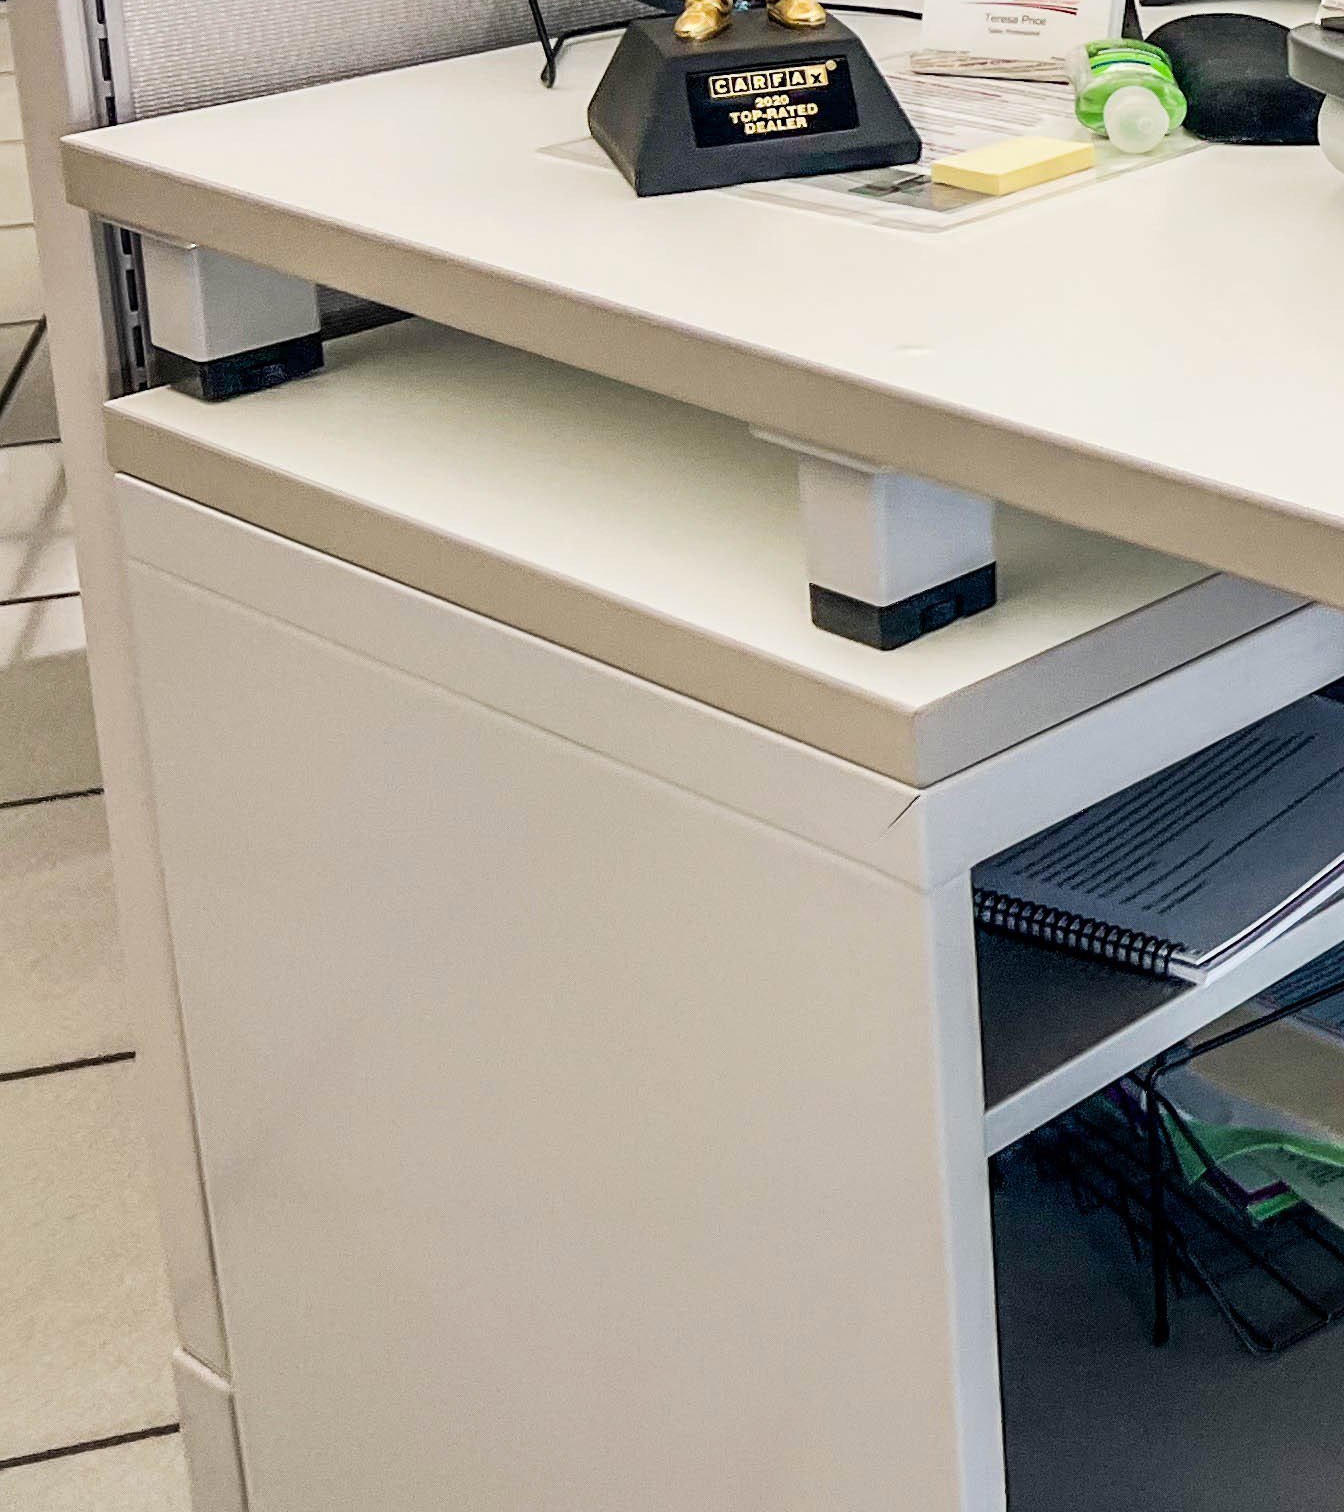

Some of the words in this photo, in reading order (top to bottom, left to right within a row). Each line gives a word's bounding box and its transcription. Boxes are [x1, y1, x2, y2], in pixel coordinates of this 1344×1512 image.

[713, 67, 826, 96] CARFAX
[754, 94, 790, 109] 2020
[729, 102, 819, 125] TOP-RATED
[743, 116, 808, 135] DEALER
